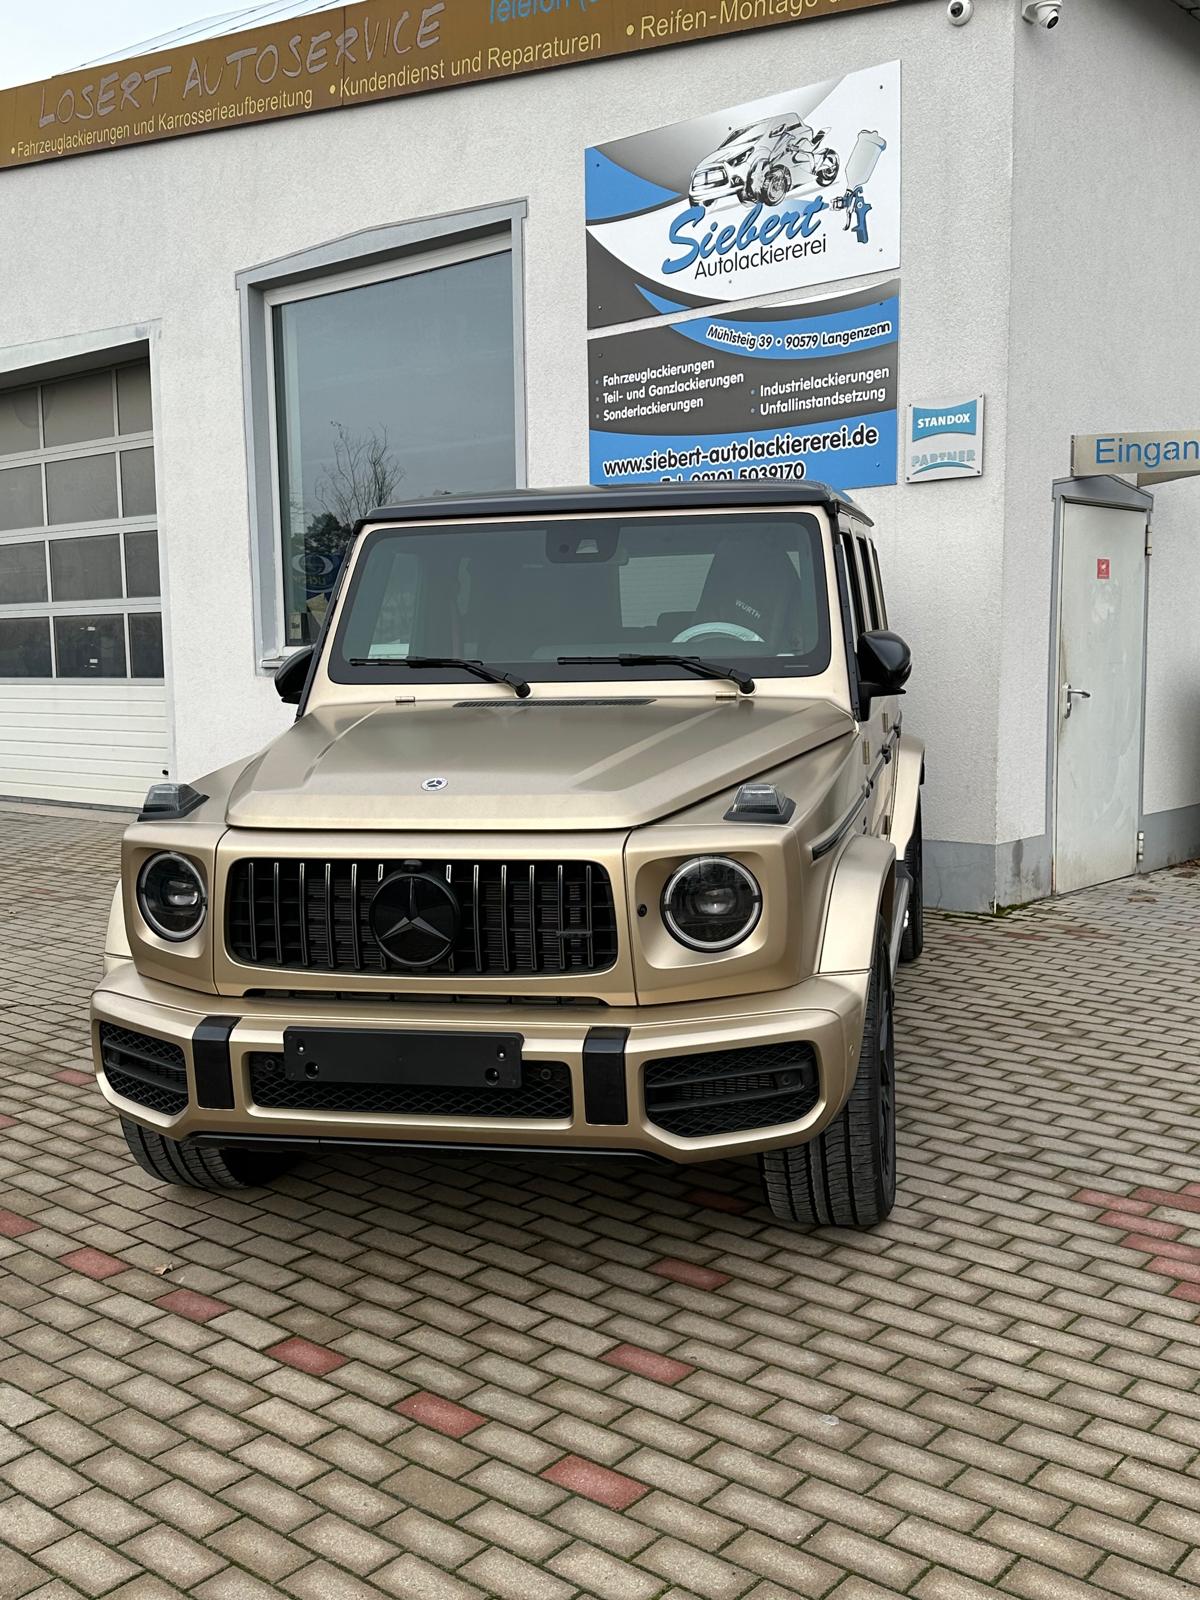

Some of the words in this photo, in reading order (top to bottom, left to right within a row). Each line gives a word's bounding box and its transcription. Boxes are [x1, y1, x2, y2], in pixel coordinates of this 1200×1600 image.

[38, 65, 172, 128] LOSERT
[182, 2, 446, 100] AUTOSERVICE
[340, 60, 445, 97] Kundendienst
[451, 51, 481, 77] und
[487, 32, 601, 70] Reparaturen
[17, 123, 130, 158] Fahrzeuglackierungen
[133, 112, 154, 133] und
[158, 88, 313, 131] Karrosserieaufbereitung
[661, 195, 829, 275] Siebert
[694, 234, 827, 280] Autolackiererei
[707, 326, 757, 349] Mühlsteig
[758, 336, 773, 348] 39
[786, 335, 818, 348] 90579
[822, 322, 890, 345] Langenzenn
[603, 359, 715, 386] Fahrzeuglackierungen
[760, 367, 890, 397] Industrielackierungen
[603, 390, 623, 404] Teil-
[626, 386, 646, 401] und
[648, 372, 744, 397] Ganzlackierungen
[760, 388, 886, 416] Unfallinstandsetzung
[603, 397, 704, 421] Sonderlackierungen
[917, 413, 970, 429] STANDOX
[604, 425, 878, 476] www.siebert-autolackiererei.de
[911, 449, 976, 467] PARTNER
[739, 462, 804, 480] 5039170
